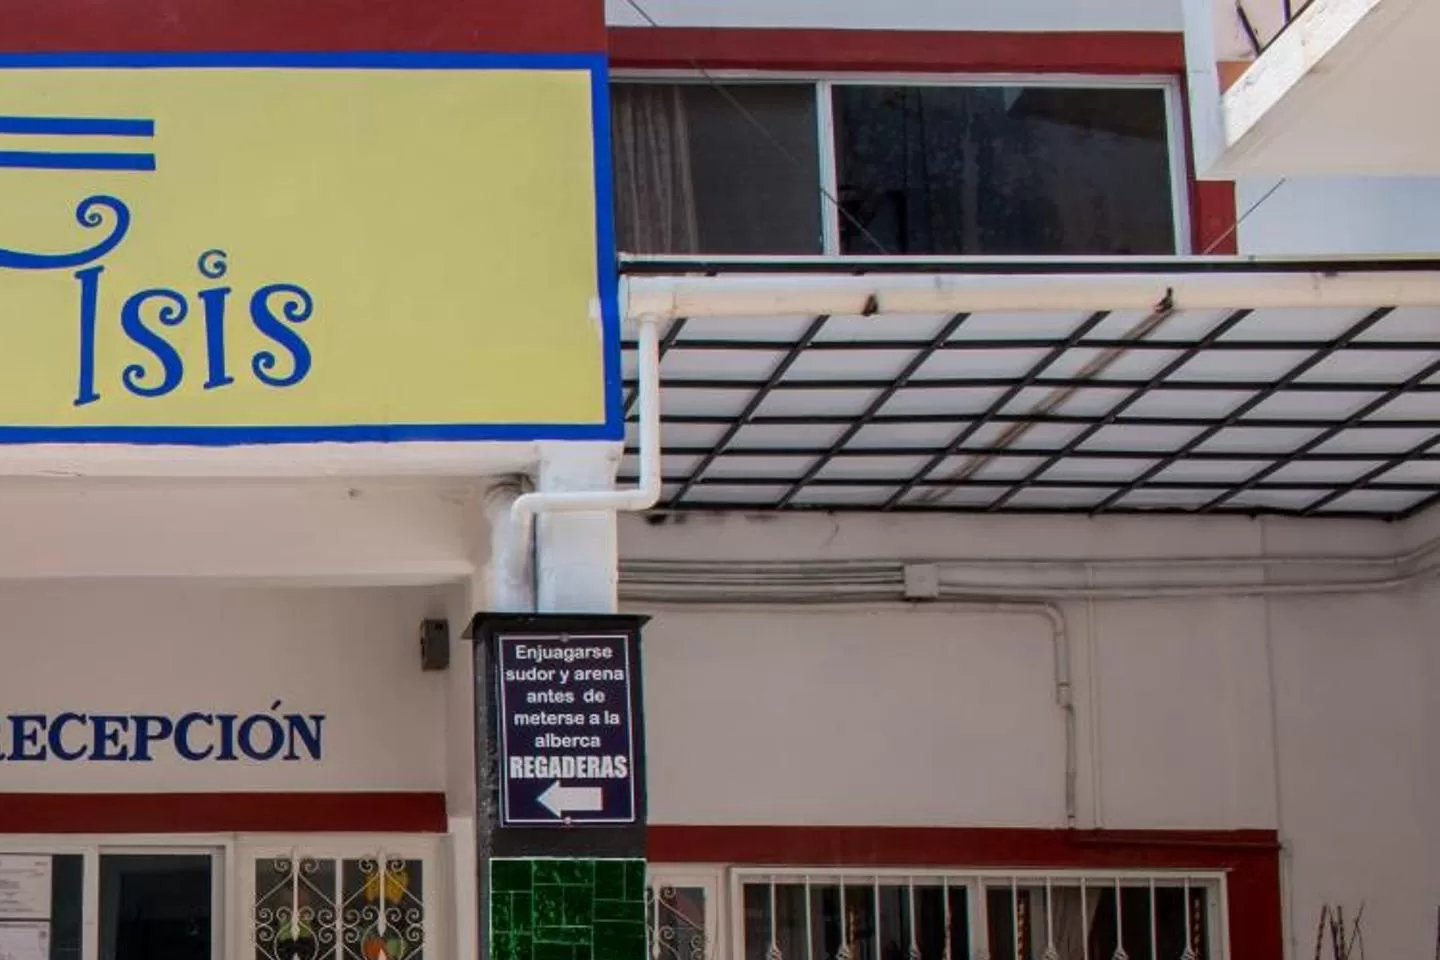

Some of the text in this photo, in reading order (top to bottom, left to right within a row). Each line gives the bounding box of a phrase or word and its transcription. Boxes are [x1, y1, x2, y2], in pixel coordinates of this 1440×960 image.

[73, 248, 314, 407] Isis
[515, 644, 613, 662] Enjuagarse
[506, 668, 624, 684] sudor y arena
[526, 688, 606, 703] antes de
[514, 710, 620, 725] meterse a la
[534, 732, 601, 748] alberca
[510, 755, 629, 779] REGADERAS
